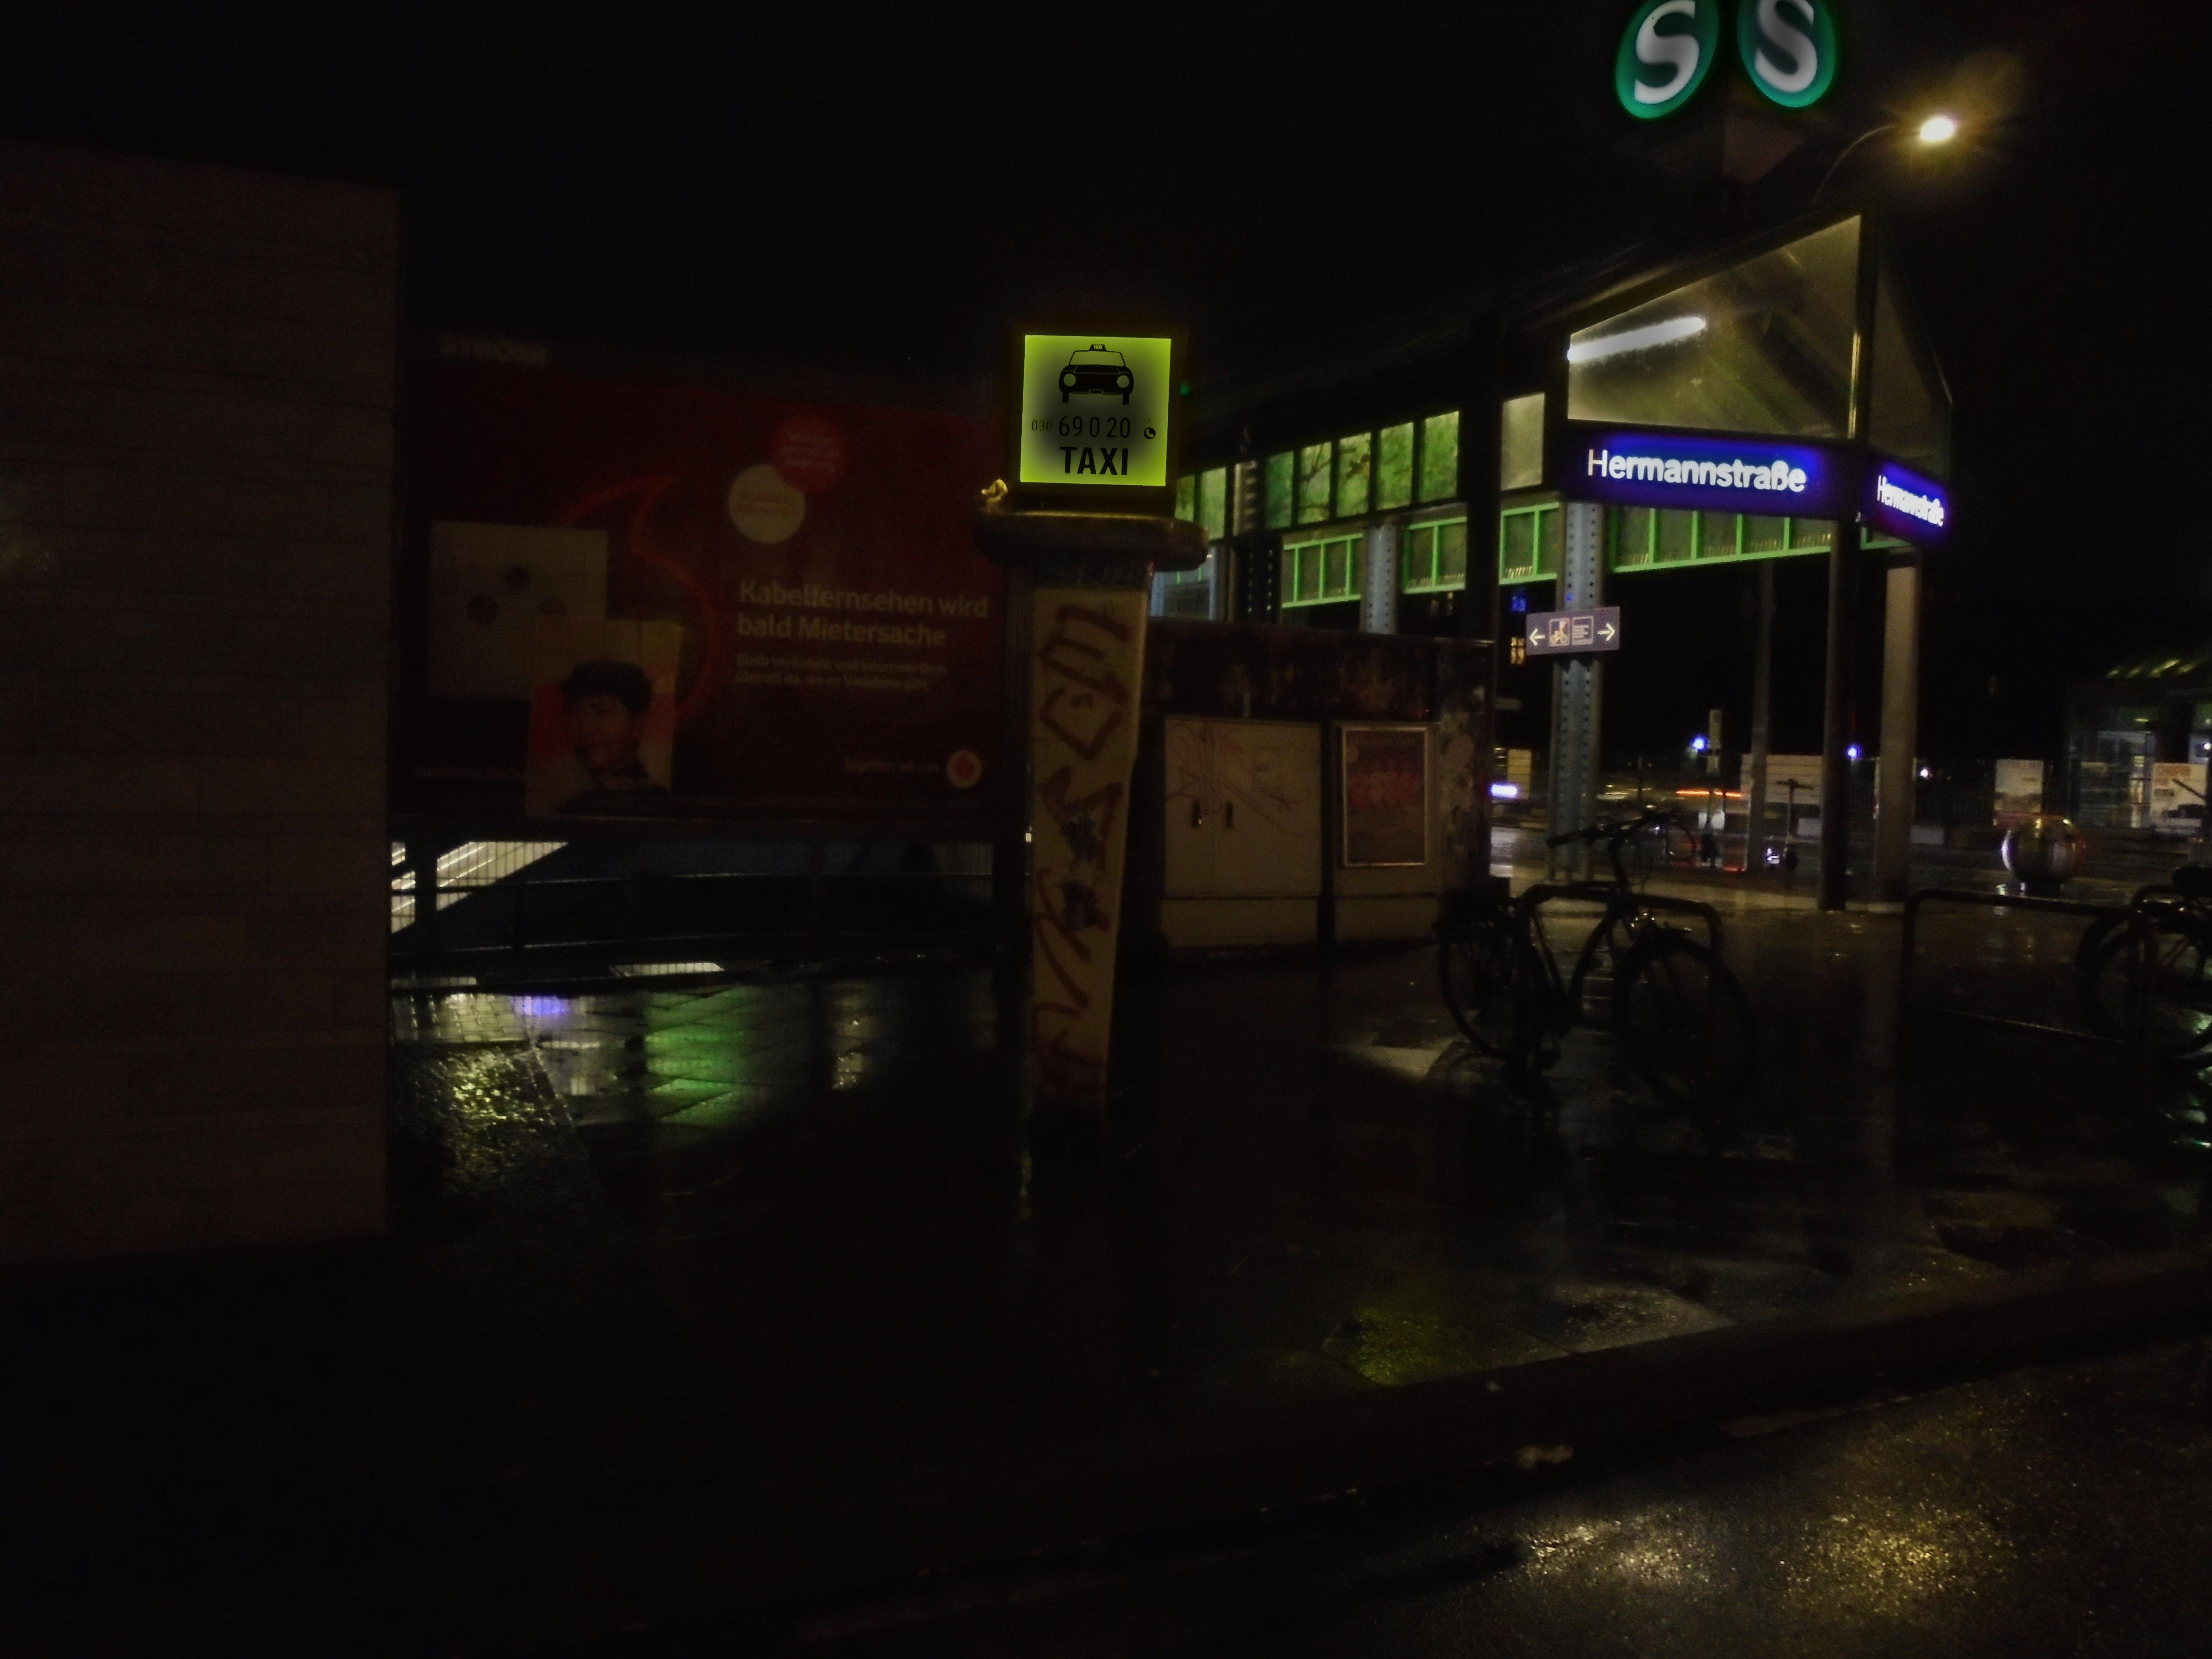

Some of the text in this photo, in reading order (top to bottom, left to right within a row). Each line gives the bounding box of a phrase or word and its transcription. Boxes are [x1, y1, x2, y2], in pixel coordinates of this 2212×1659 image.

[1634, 0, 1700, 104] S
[1755, 0, 1818, 93] S
[1032, 420, 1052, 431] 030
[1060, 446, 1128, 476] TAXI
[1587, 449, 1807, 493] Hermannstraße
[1876, 474, 1945, 527] Hermannstraße
[740, 579, 988, 618] Kabelfernsehen wird
[738, 612, 947, 647] bald Mietersache
